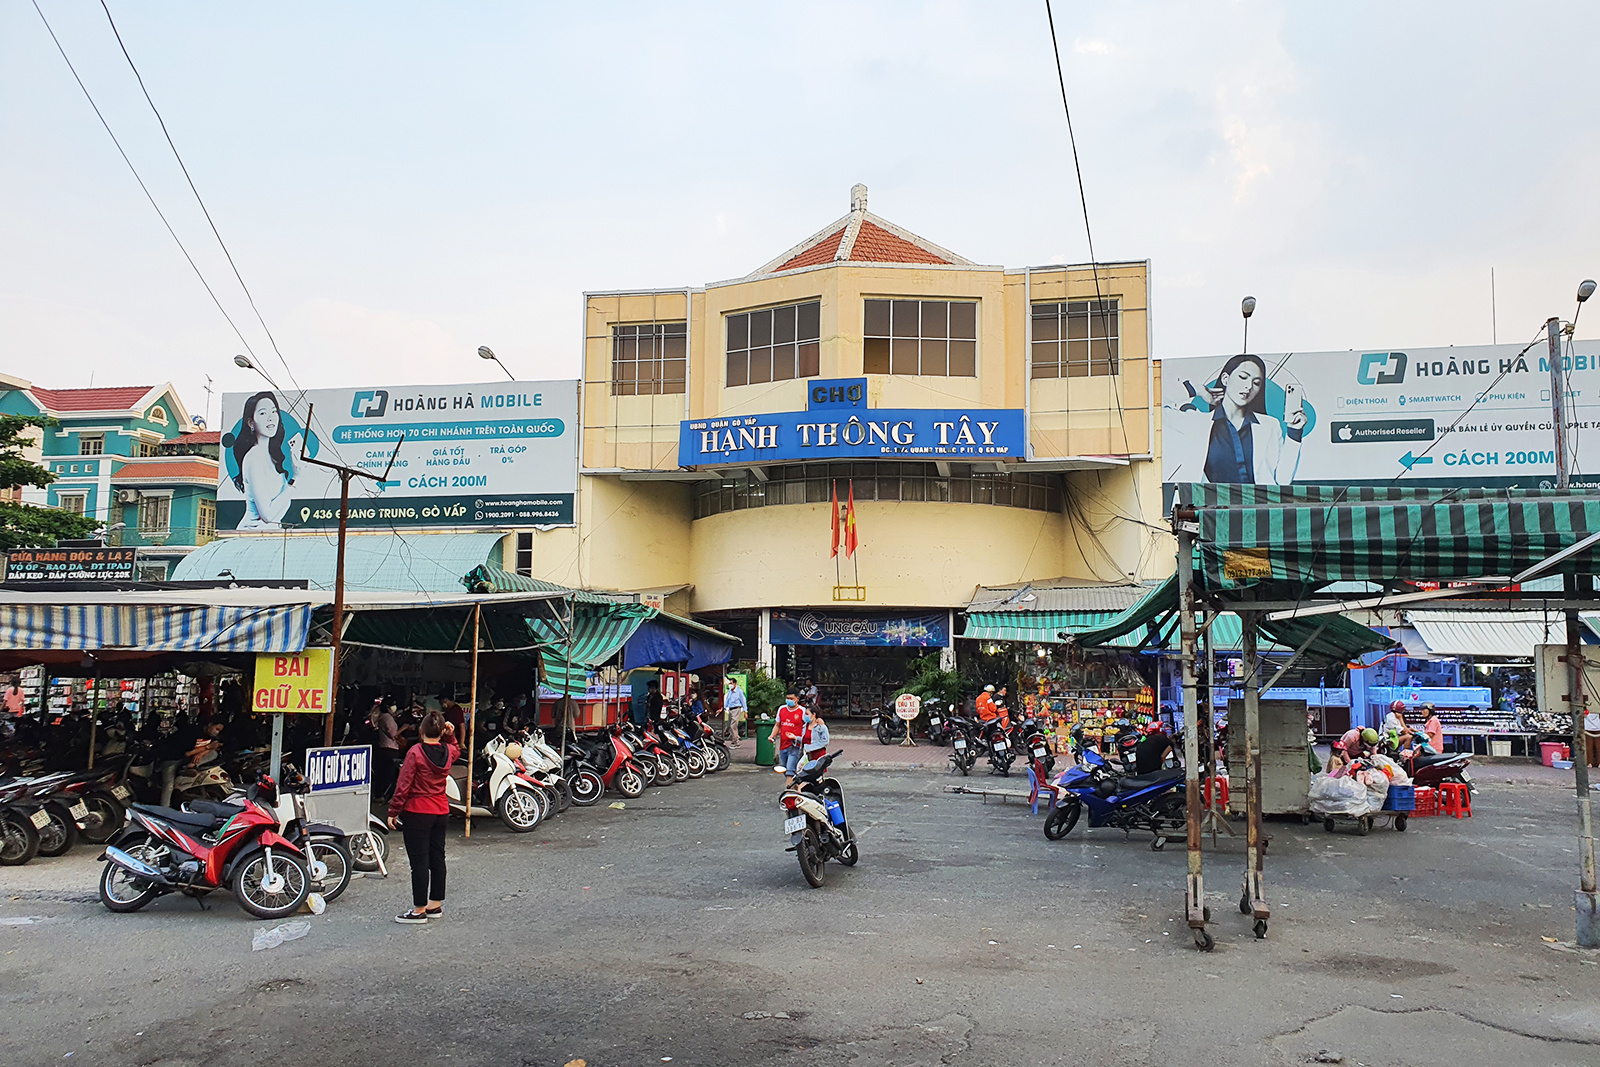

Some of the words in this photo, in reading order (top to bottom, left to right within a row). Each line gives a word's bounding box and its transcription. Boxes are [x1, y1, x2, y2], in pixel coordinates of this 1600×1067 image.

[1416, 356, 1491, 377] HOÀNG
[1499, 353, 1529, 373] HÀ
[1539, 355, 1600, 372] MOBI
[812, 383, 863, 406] CHỢ
[1409, 395, 1461, 403] SMARTWATCH
[1489, 393, 1505, 401] PHỤ
[1507, 392, 1526, 400] KIỆN
[394, 394, 447, 411] HOÀNG
[453, 392, 474, 409] HÀ
[481, 393, 542, 408] MOBILE
[1346, 398, 1364, 406] ĐIỆN
[1365, 397, 1388, 406] THOẠI
[341, 429, 352, 441] HỆ
[354, 427, 384, 438] THỐNG
[387, 429, 406, 438] HƠN
[409, 429, 419, 437] 70
[421, 428, 437, 436] CHI
[440, 426, 472, 436] NHÁNH
[475, 425, 496, 435] TRÊN
[499, 424, 523, 434] TOÀN
[526, 422, 555, 433] QUỐC
[690, 422, 707, 430] UBND
[1355, 428, 1395, 436] Authorised
[1396, 427, 1426, 435] Reseller
[1459, 423, 1477, 433] BÁN
[1539, 421, 1554, 430] CỦ
[700, 425, 778, 456] HẠNH
[796, 415, 915, 447] THÔNG
[933, 414, 999, 446] TÂY
[366, 451, 384, 459] CAM
[387, 449, 400, 458] KT
[432, 447, 448, 456] GIÁ
[450, 445, 465, 456] TỐT
[490, 444, 505, 454] TRẢ
[508, 444, 527, 453] GÓP
[426, 457, 450, 466] HÀNG
[501, 456, 514, 464] 0%
[1443, 449, 1499, 466] CÁCH
[1505, 450, 1554, 465] 200M
[356, 460, 382, 468] CHÍNH
[408, 474, 447, 488] CÁCH
[452, 475, 487, 488] 200M
[313, 509, 332, 519] 436
[379, 507, 418, 520] TRUNG,
[421, 504, 440, 517] GÒ
[443, 503, 467, 517] VẤP
[485, 511, 514, 519] 1900.2091
[10, 549, 32, 562] CỬA
[35, 550, 67, 562] HÀNG
[96, 552, 104, 561] &
[125, 551, 133, 560] 2
[46, 563, 66, 571] BAO
[68, 563, 83, 571] DA
[107, 562, 131, 570] IPAD
[8, 570, 25, 579] DÁN
[27, 571, 43, 579] KEO
[49, 570, 67, 579] DÁN
[274, 651, 309, 677] BÃI
[256, 684, 291, 709] GIỮ
[297, 689, 324, 709] XE
[310, 751, 323, 785] BÃI
[325, 750, 339, 784] GIỮ
[340, 754, 350, 781] XE
[352, 750, 367, 785] CHỢ
